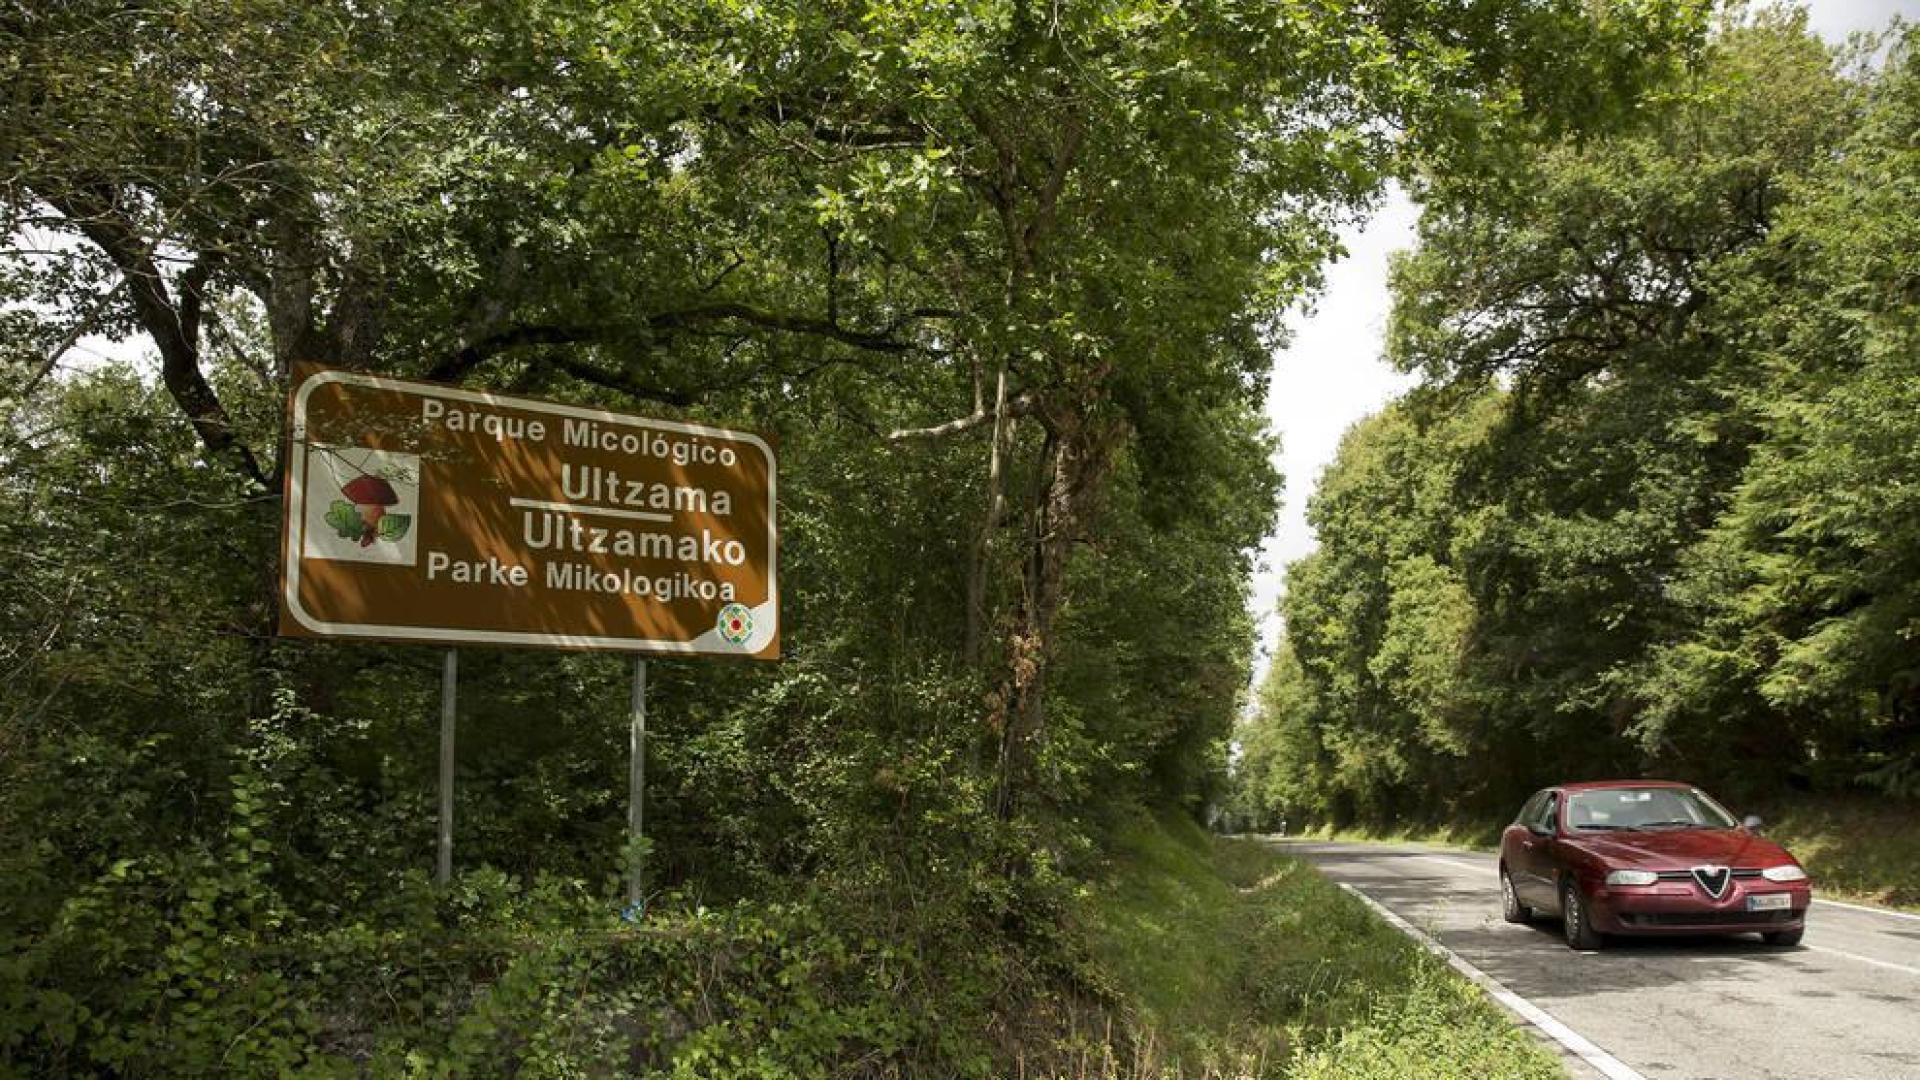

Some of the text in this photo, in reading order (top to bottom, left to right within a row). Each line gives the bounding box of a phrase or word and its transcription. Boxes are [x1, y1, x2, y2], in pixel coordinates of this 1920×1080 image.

[422, 399, 737, 467] Parque Micológico
[561, 463, 732, 516] Ultzama
[522, 511, 746, 567] Ultzamako
[427, 551, 736, 602] Parke Mikologikoa
